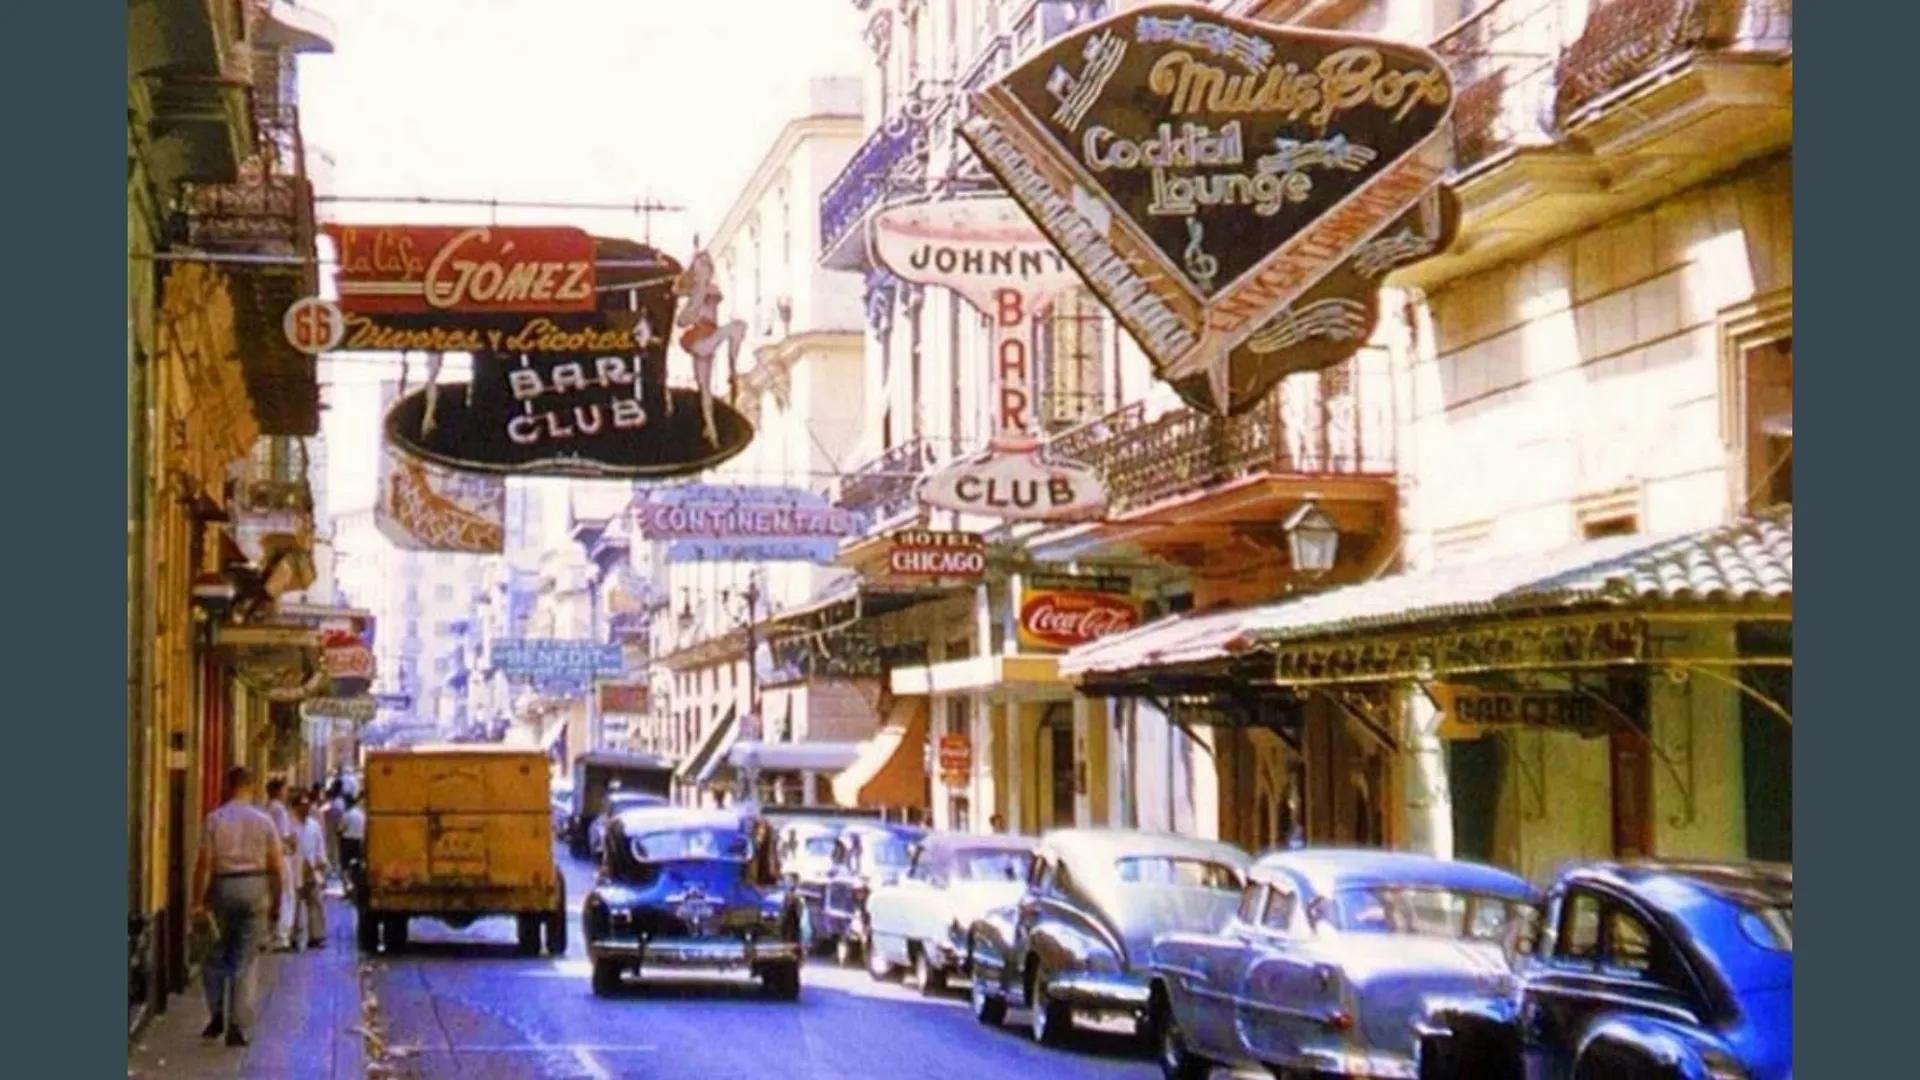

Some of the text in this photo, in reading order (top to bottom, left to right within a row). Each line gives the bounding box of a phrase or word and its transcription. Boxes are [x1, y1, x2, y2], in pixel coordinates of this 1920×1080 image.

[1149, 46, 1449, 136] Music Box
[1082, 119, 1244, 172] Cocktail
[1146, 166, 1313, 217] Lounge
[424, 227, 593, 309] GÓMEZ
[294, 302, 332, 348] 66
[506, 316, 635, 352] Licores
[508, 355, 635, 400] BAR
[993, 288, 1026, 430] BAR
[507, 396, 648, 444] CLUB
[954, 474, 1075, 509] CLUB
[653, 504, 846, 535] CONTINENTAL
[891, 550, 985, 574] CHICAGO
